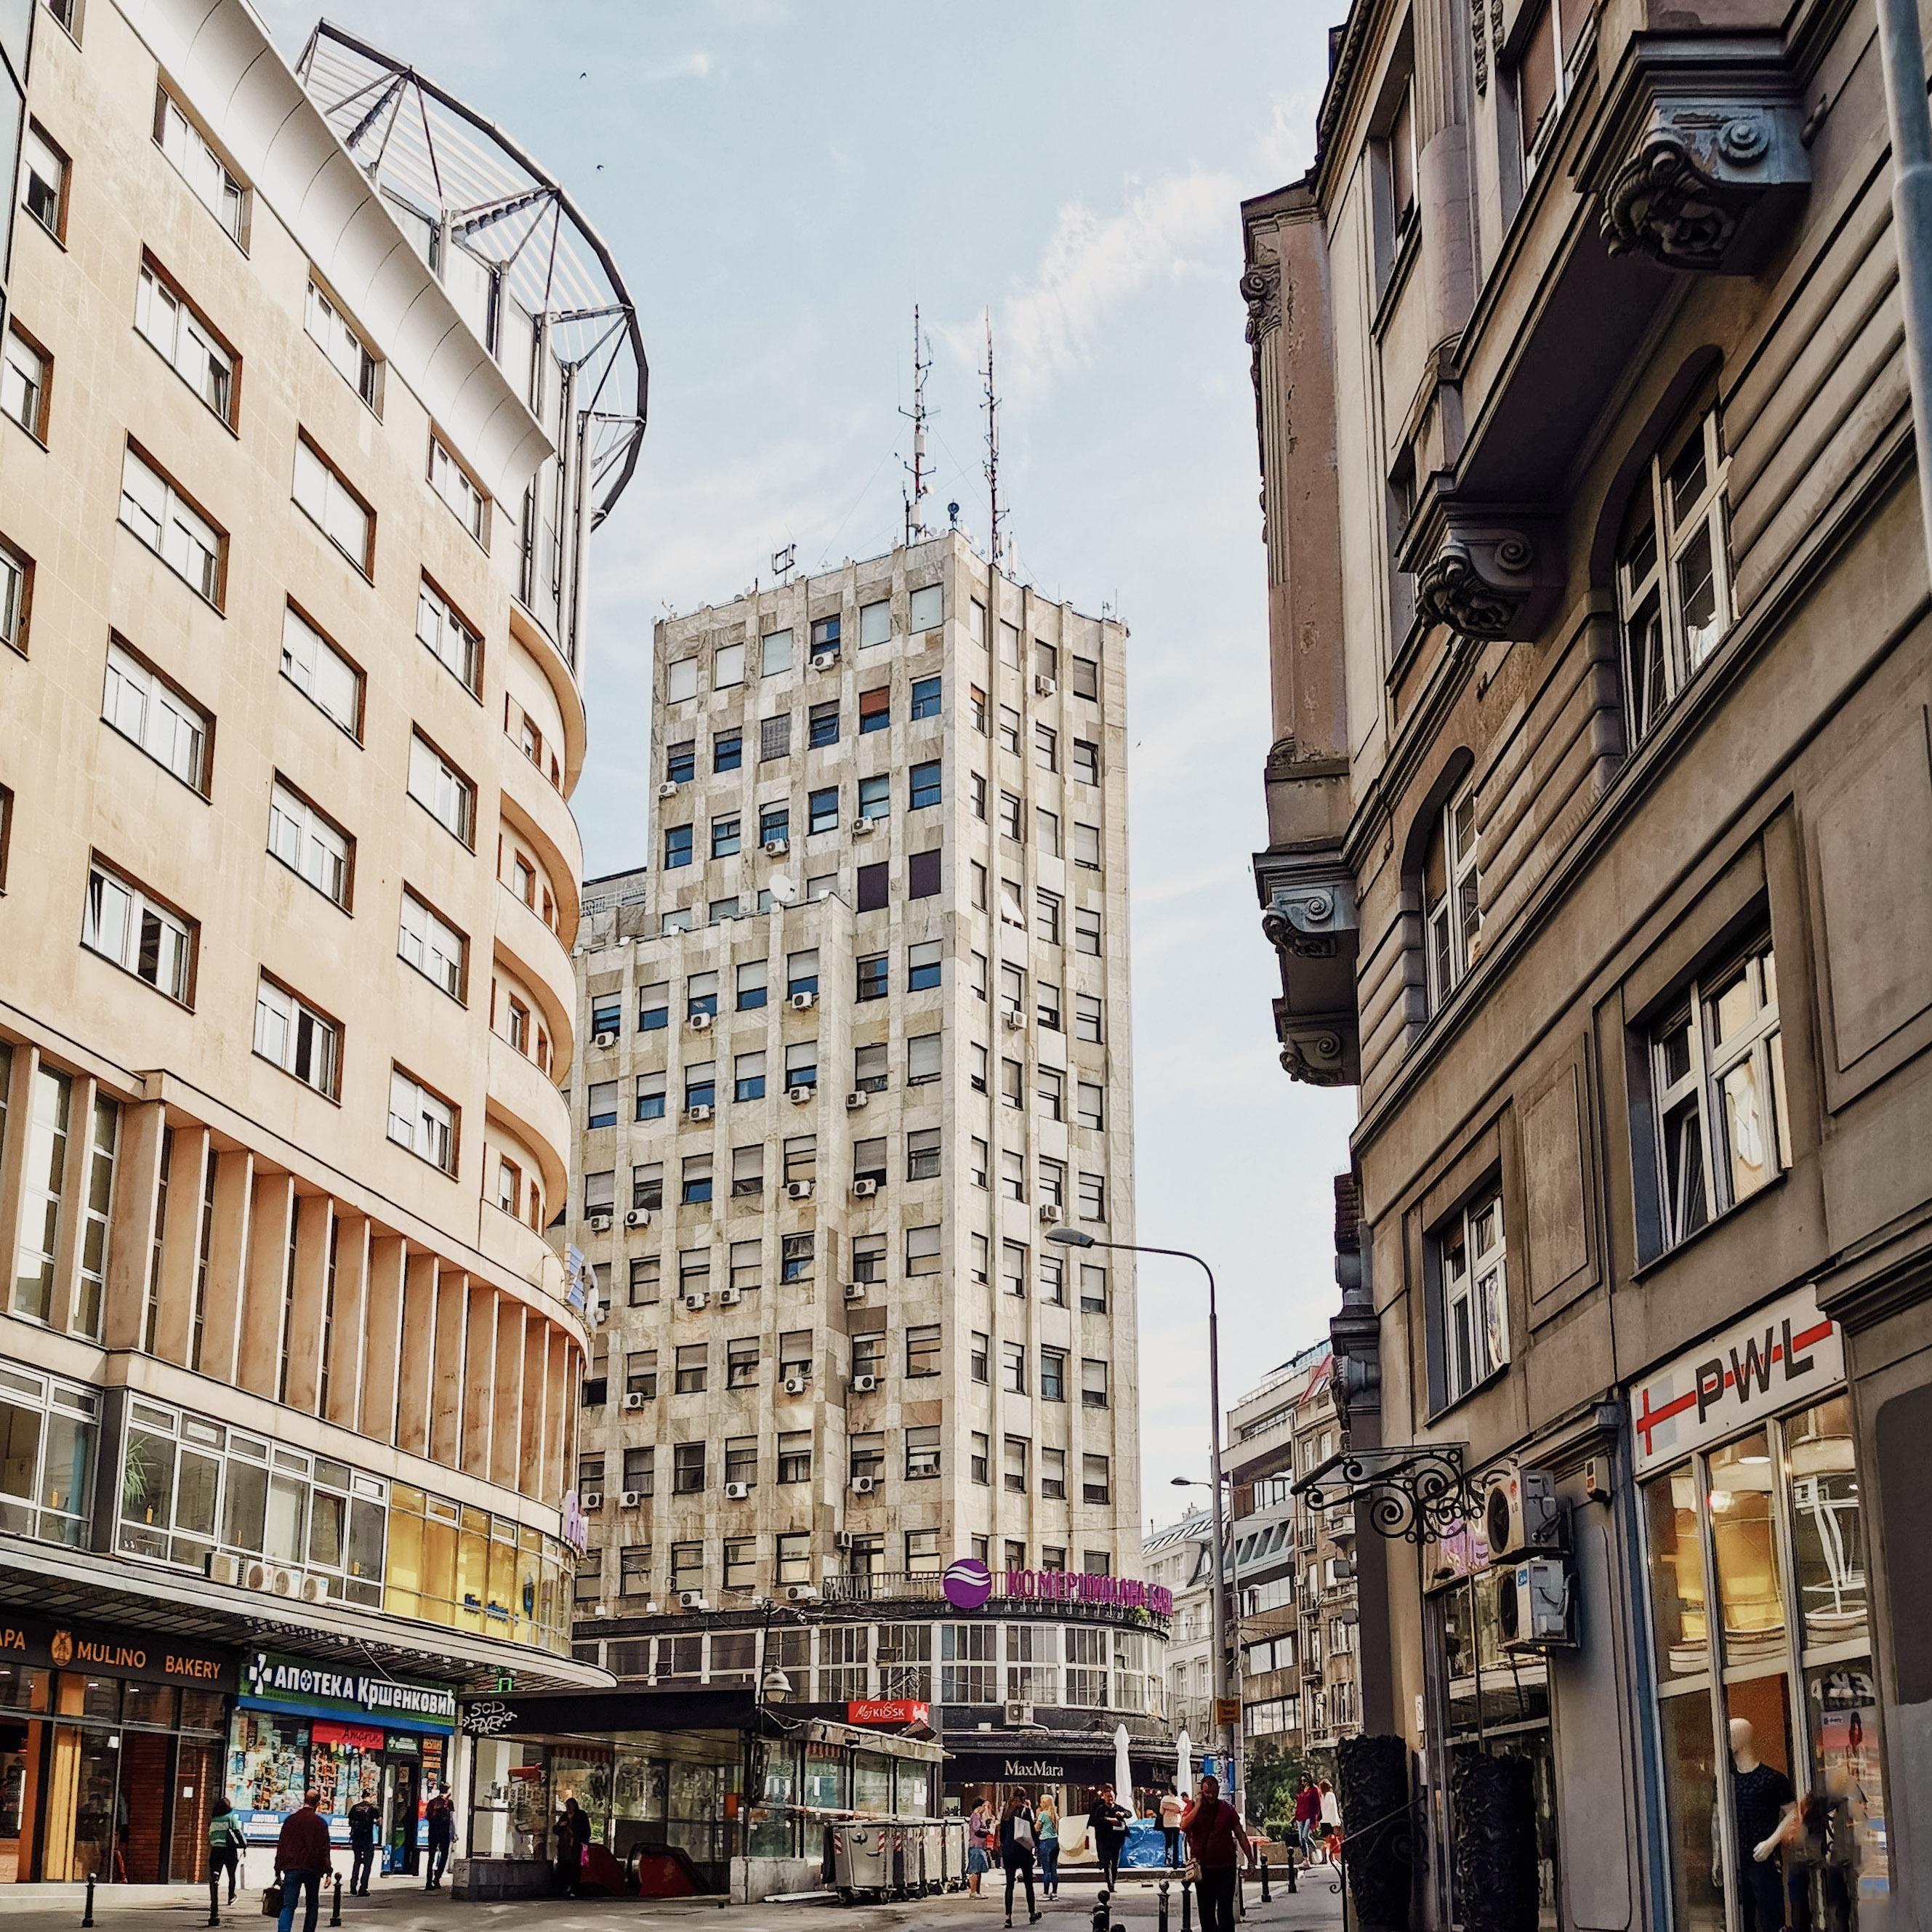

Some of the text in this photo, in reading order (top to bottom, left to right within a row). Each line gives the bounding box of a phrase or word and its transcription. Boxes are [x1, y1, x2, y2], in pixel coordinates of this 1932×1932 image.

[1696, 1318, 1814, 1425] PWL
[0, 1628, 25, 1650] РА
[77, 1641, 222, 1679] MULINO BAKERY
[274, 1665, 456, 1716] АПОТЕКА Кршенковић
[873, 1702, 904, 1719] KIOSK
[1005, 1760, 1063, 1776] MaxMara
